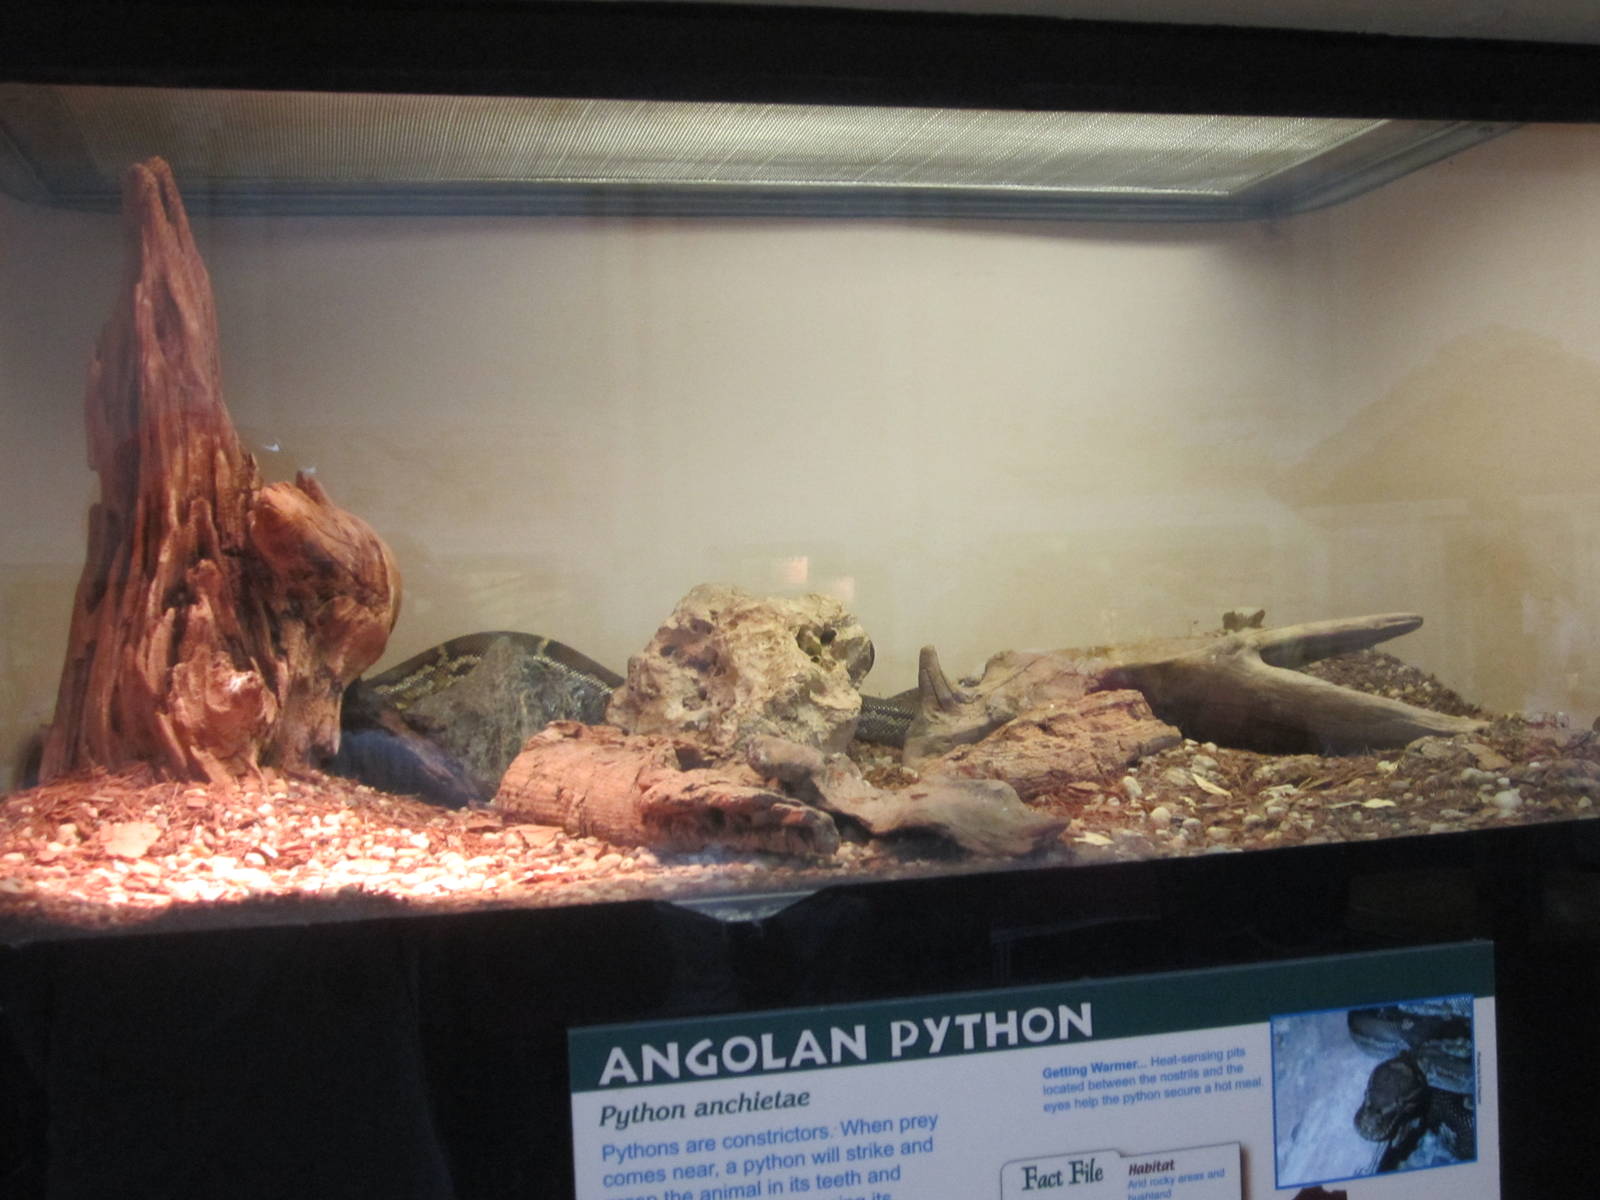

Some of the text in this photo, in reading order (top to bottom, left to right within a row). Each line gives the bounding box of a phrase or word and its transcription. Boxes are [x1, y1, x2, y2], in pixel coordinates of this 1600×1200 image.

[598, 1002, 1093, 1086] ANGOLAN PYTHON
[1042, 1065, 1088, 1080] Getting
[1151, 1049, 1223, 1067] Heat-sensing
[1226, 1047, 1246, 1060] pits
[1043, 1062, 1243, 1094] located between the nostrils and the
[599, 1091, 811, 1130] Python anchietae
[1043, 1077, 1264, 1113] eyes help the python secure a hot meal.
[602, 1114, 938, 1165] Pythons are constrictors. When prey
[603, 1137, 934, 1188] comes near, a python will strike and
[1021, 1158, 1104, 1191] Fact File
[1128, 1160, 1175, 1176] Habitat
[1150, 1176, 1175, 1186] rocky
[1178, 1173, 1204, 1183] areas
[1207, 1168, 1225, 1179] and
[701, 1181, 762, 1200] animal
[768, 1179, 783, 1195] in
[790, 1176, 810, 1192] its
[816, 1170, 861, 1189] teeth
[867, 1165, 901, 1184] and
